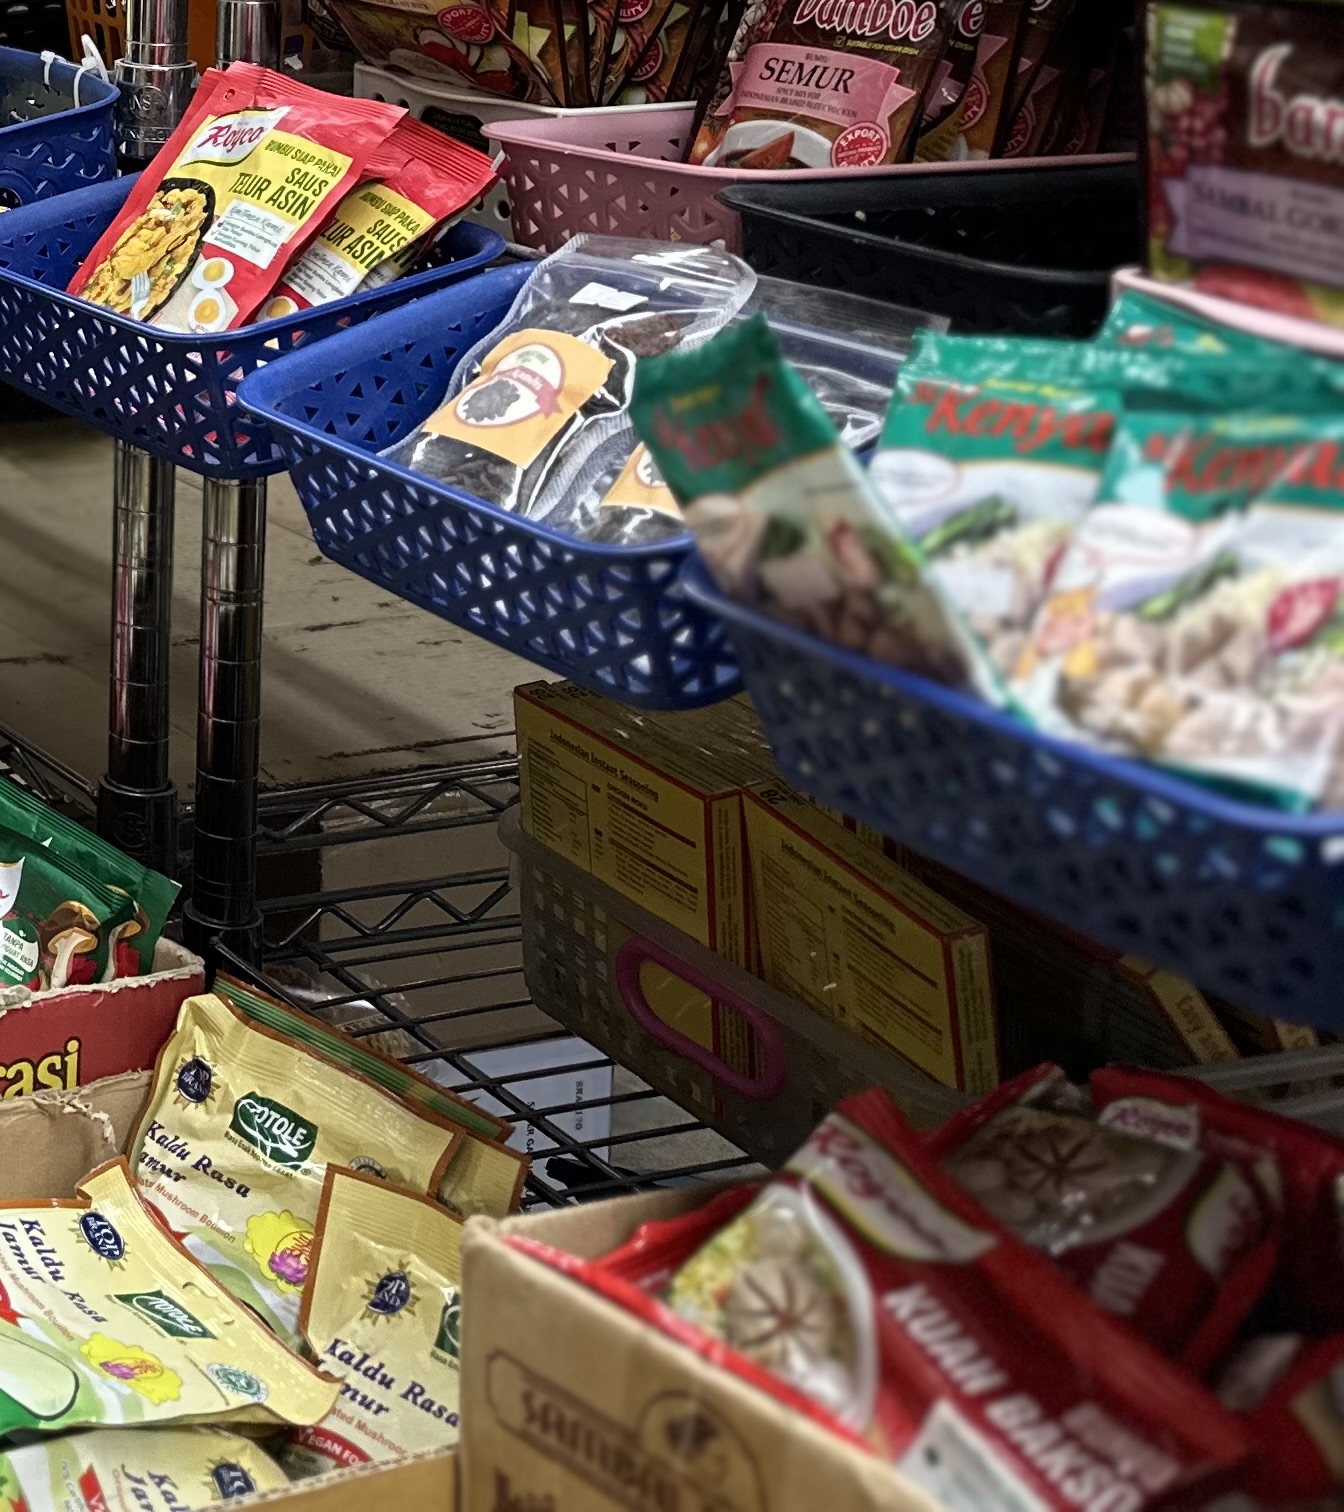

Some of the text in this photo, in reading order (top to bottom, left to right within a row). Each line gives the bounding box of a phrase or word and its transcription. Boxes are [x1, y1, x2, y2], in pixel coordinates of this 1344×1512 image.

[759, 57, 856, 94] SEMUR
[197, 124, 264, 154] Royco
[265, 140, 292, 156] BUMBU
[291, 148, 315, 166] SIAP
[839, 128, 882, 147] EXPORT
[285, 168, 329, 197] SAUS
[265, 186, 316, 221] ASIN
[138, 1149, 187, 1184] amur
[146, 1120, 251, 1199] Kaldu Rasa
[19, 1217, 108, 1323] Kaldu Rasa
[147, 1294, 204, 1337] TOTOLE
[324, 1337, 460, 1428] Kaldu Rasa
[297, 1425, 341, 1457] VEGAN
